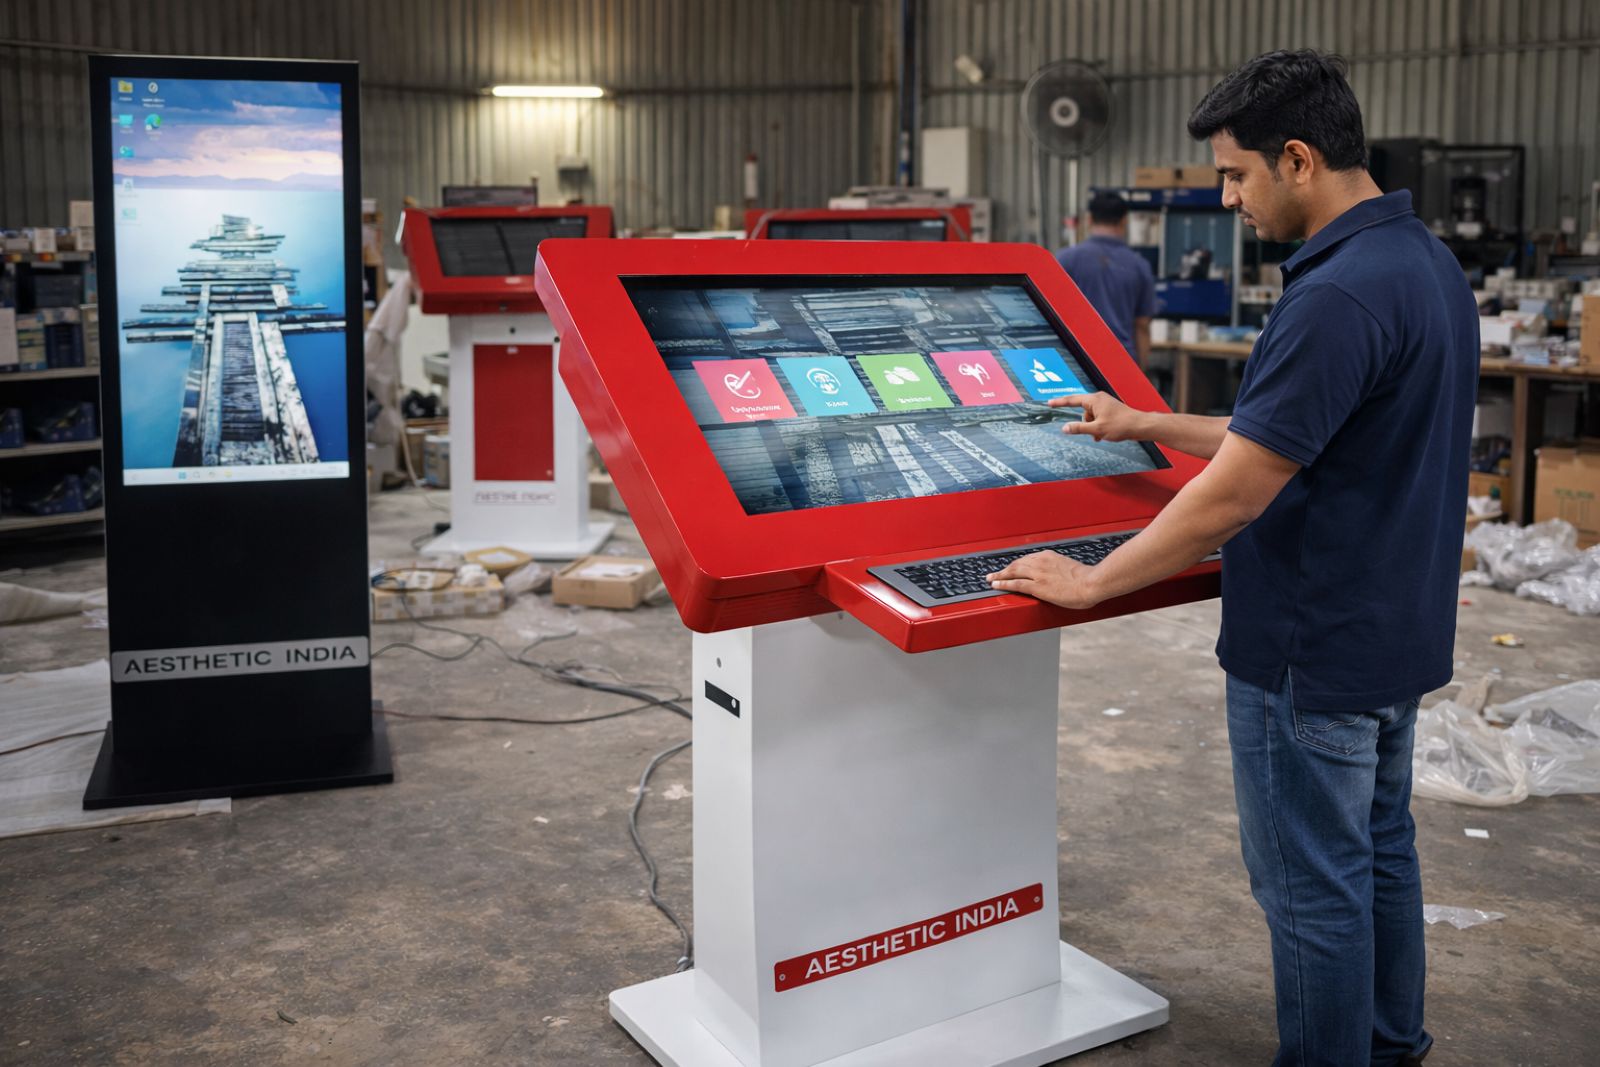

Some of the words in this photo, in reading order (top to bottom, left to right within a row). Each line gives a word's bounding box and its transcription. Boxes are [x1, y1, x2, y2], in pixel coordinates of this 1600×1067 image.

[124, 651, 271, 674] AESTHETIC
[286, 646, 356, 663] INDIA
[805, 921, 946, 979] AESTHETIC
[956, 897, 1020, 933] INDIA
